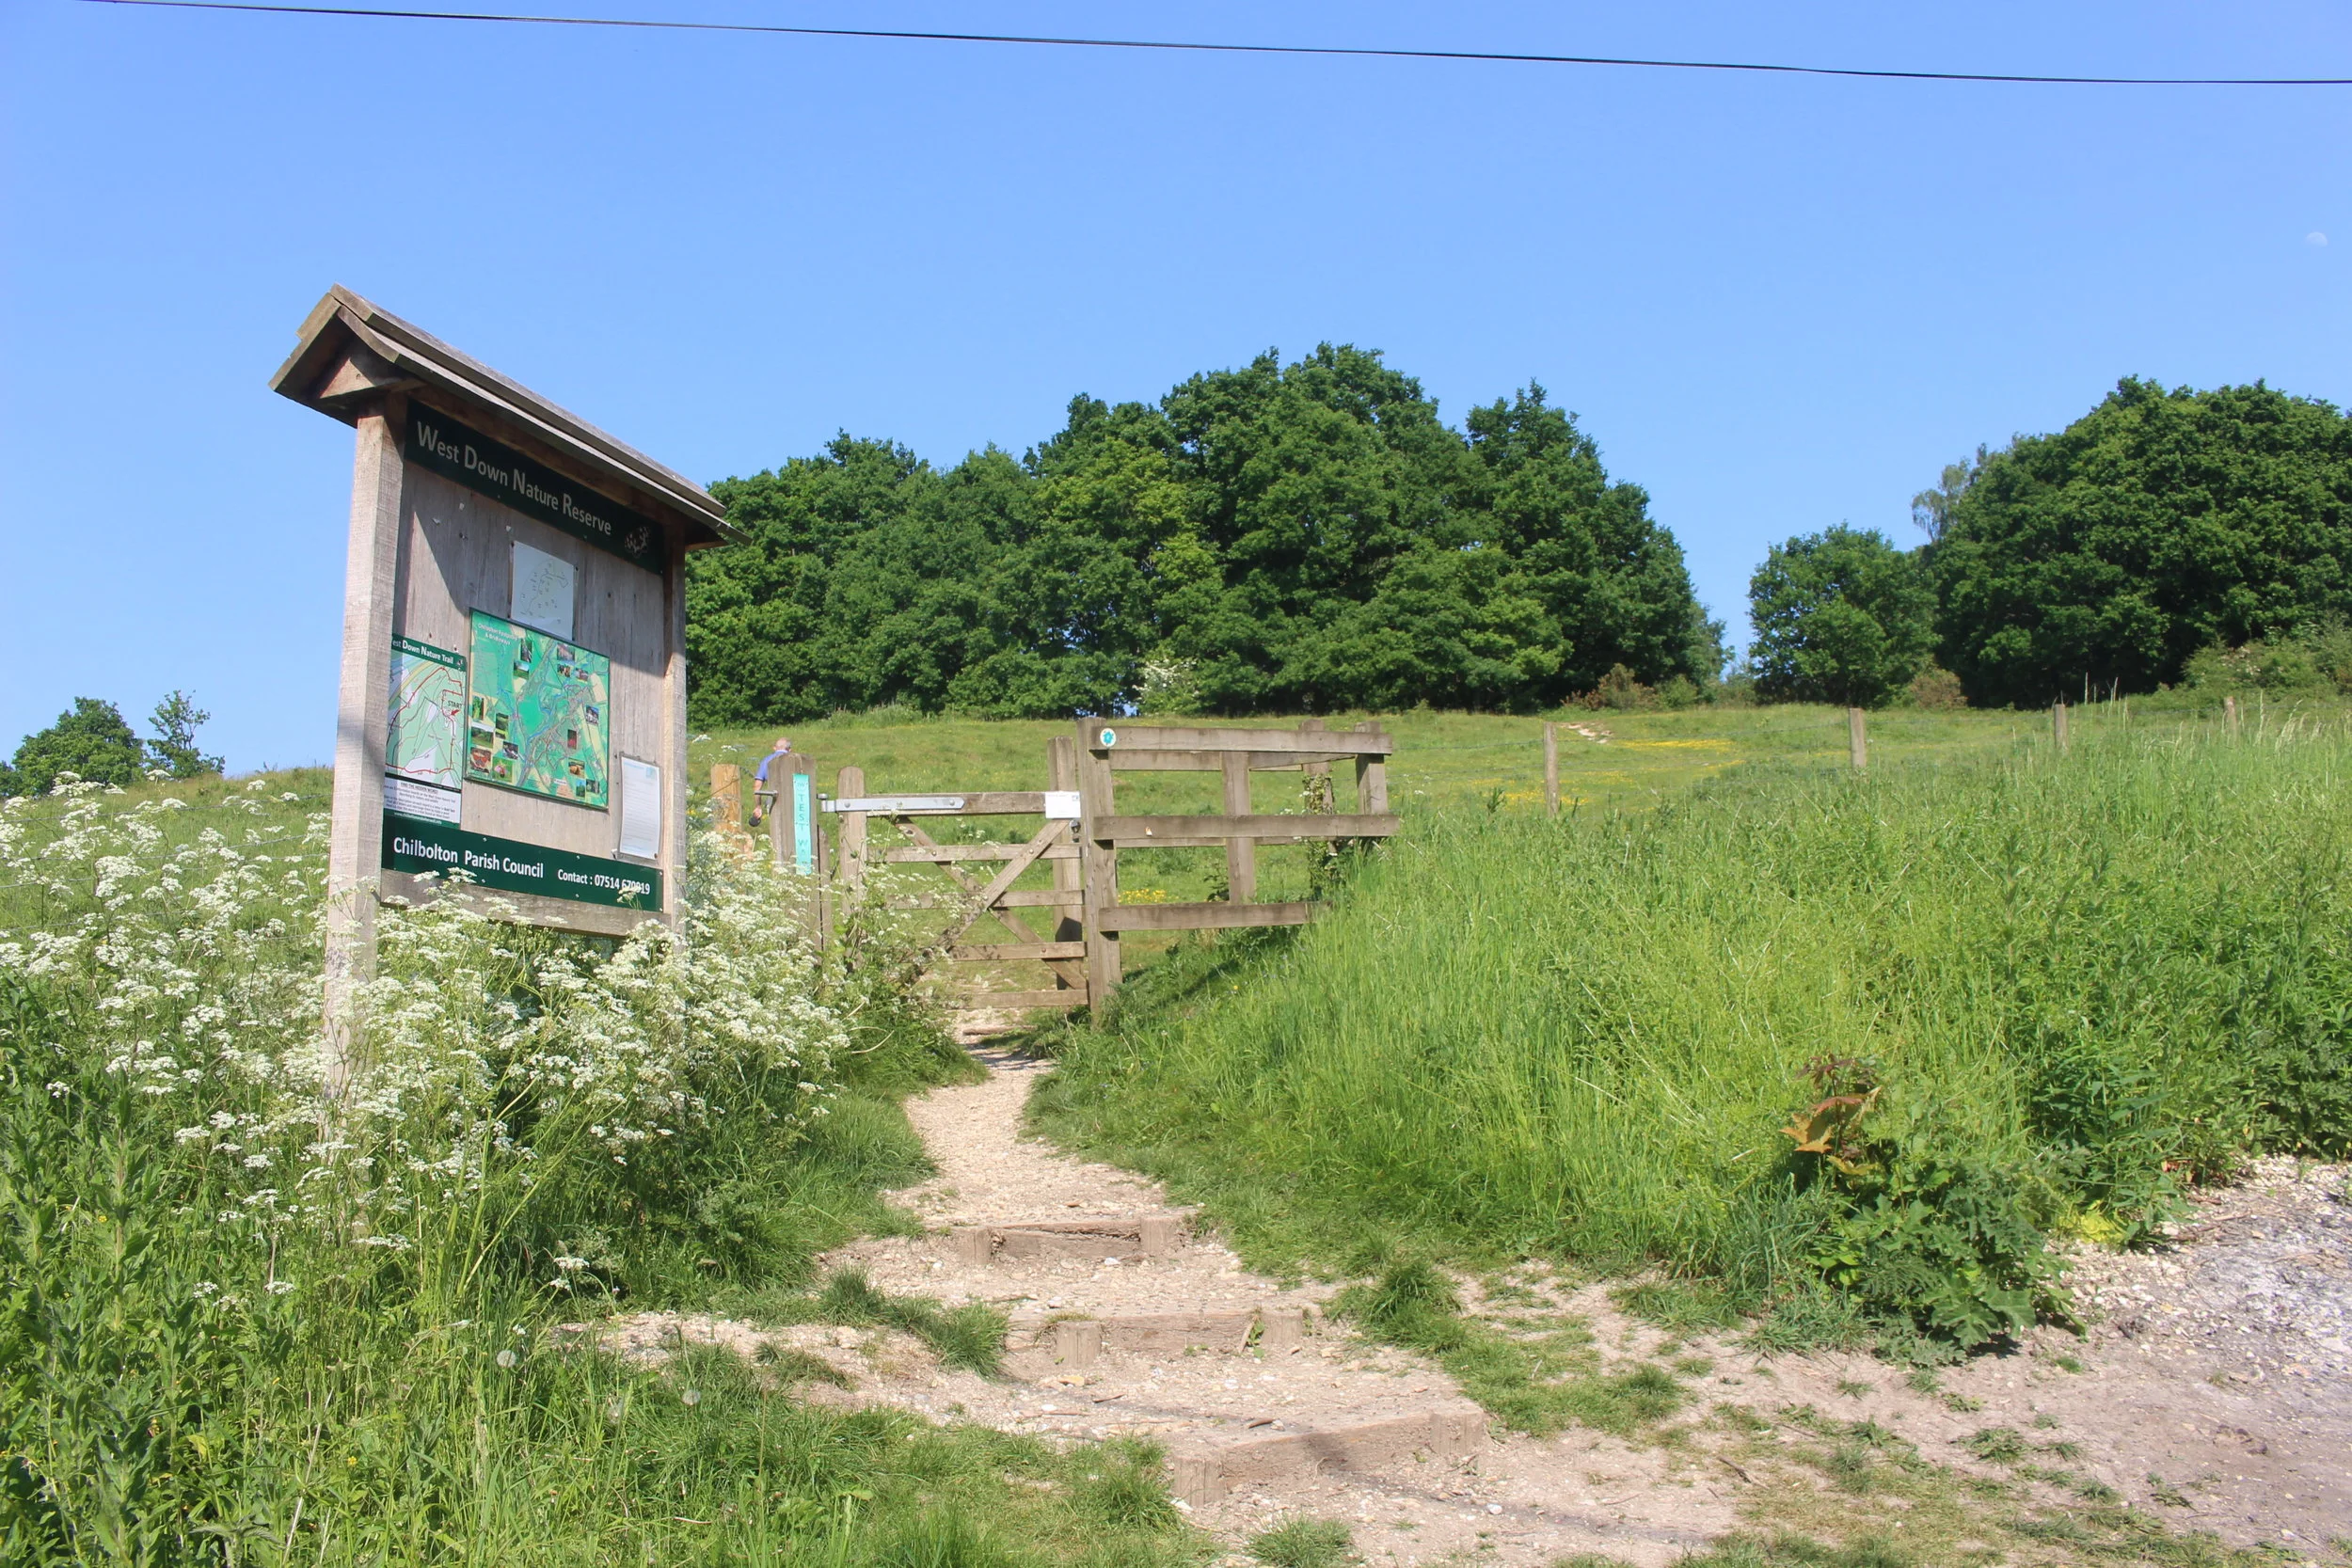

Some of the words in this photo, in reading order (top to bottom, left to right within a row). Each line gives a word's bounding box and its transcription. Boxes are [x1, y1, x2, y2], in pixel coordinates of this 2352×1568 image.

[417, 420, 460, 464] West
[464, 444, 508, 486] Down
[513, 468, 559, 510] Nature
[563, 492, 612, 535] Reserve
[391, 640, 402, 648] est
[402, 640, 421, 654] Down
[421, 646, 441, 659] Nature
[441, 654, 453, 664] Trail
[448, 700, 463, 709] START
[798, 794, 806, 832] TEST
[393, 836, 458, 863] Chilbolton
[464, 849, 500, 872] Parish
[502, 857, 544, 879] Council
[557, 868, 588, 885] Contact
[595, 874, 620, 891] 07514
